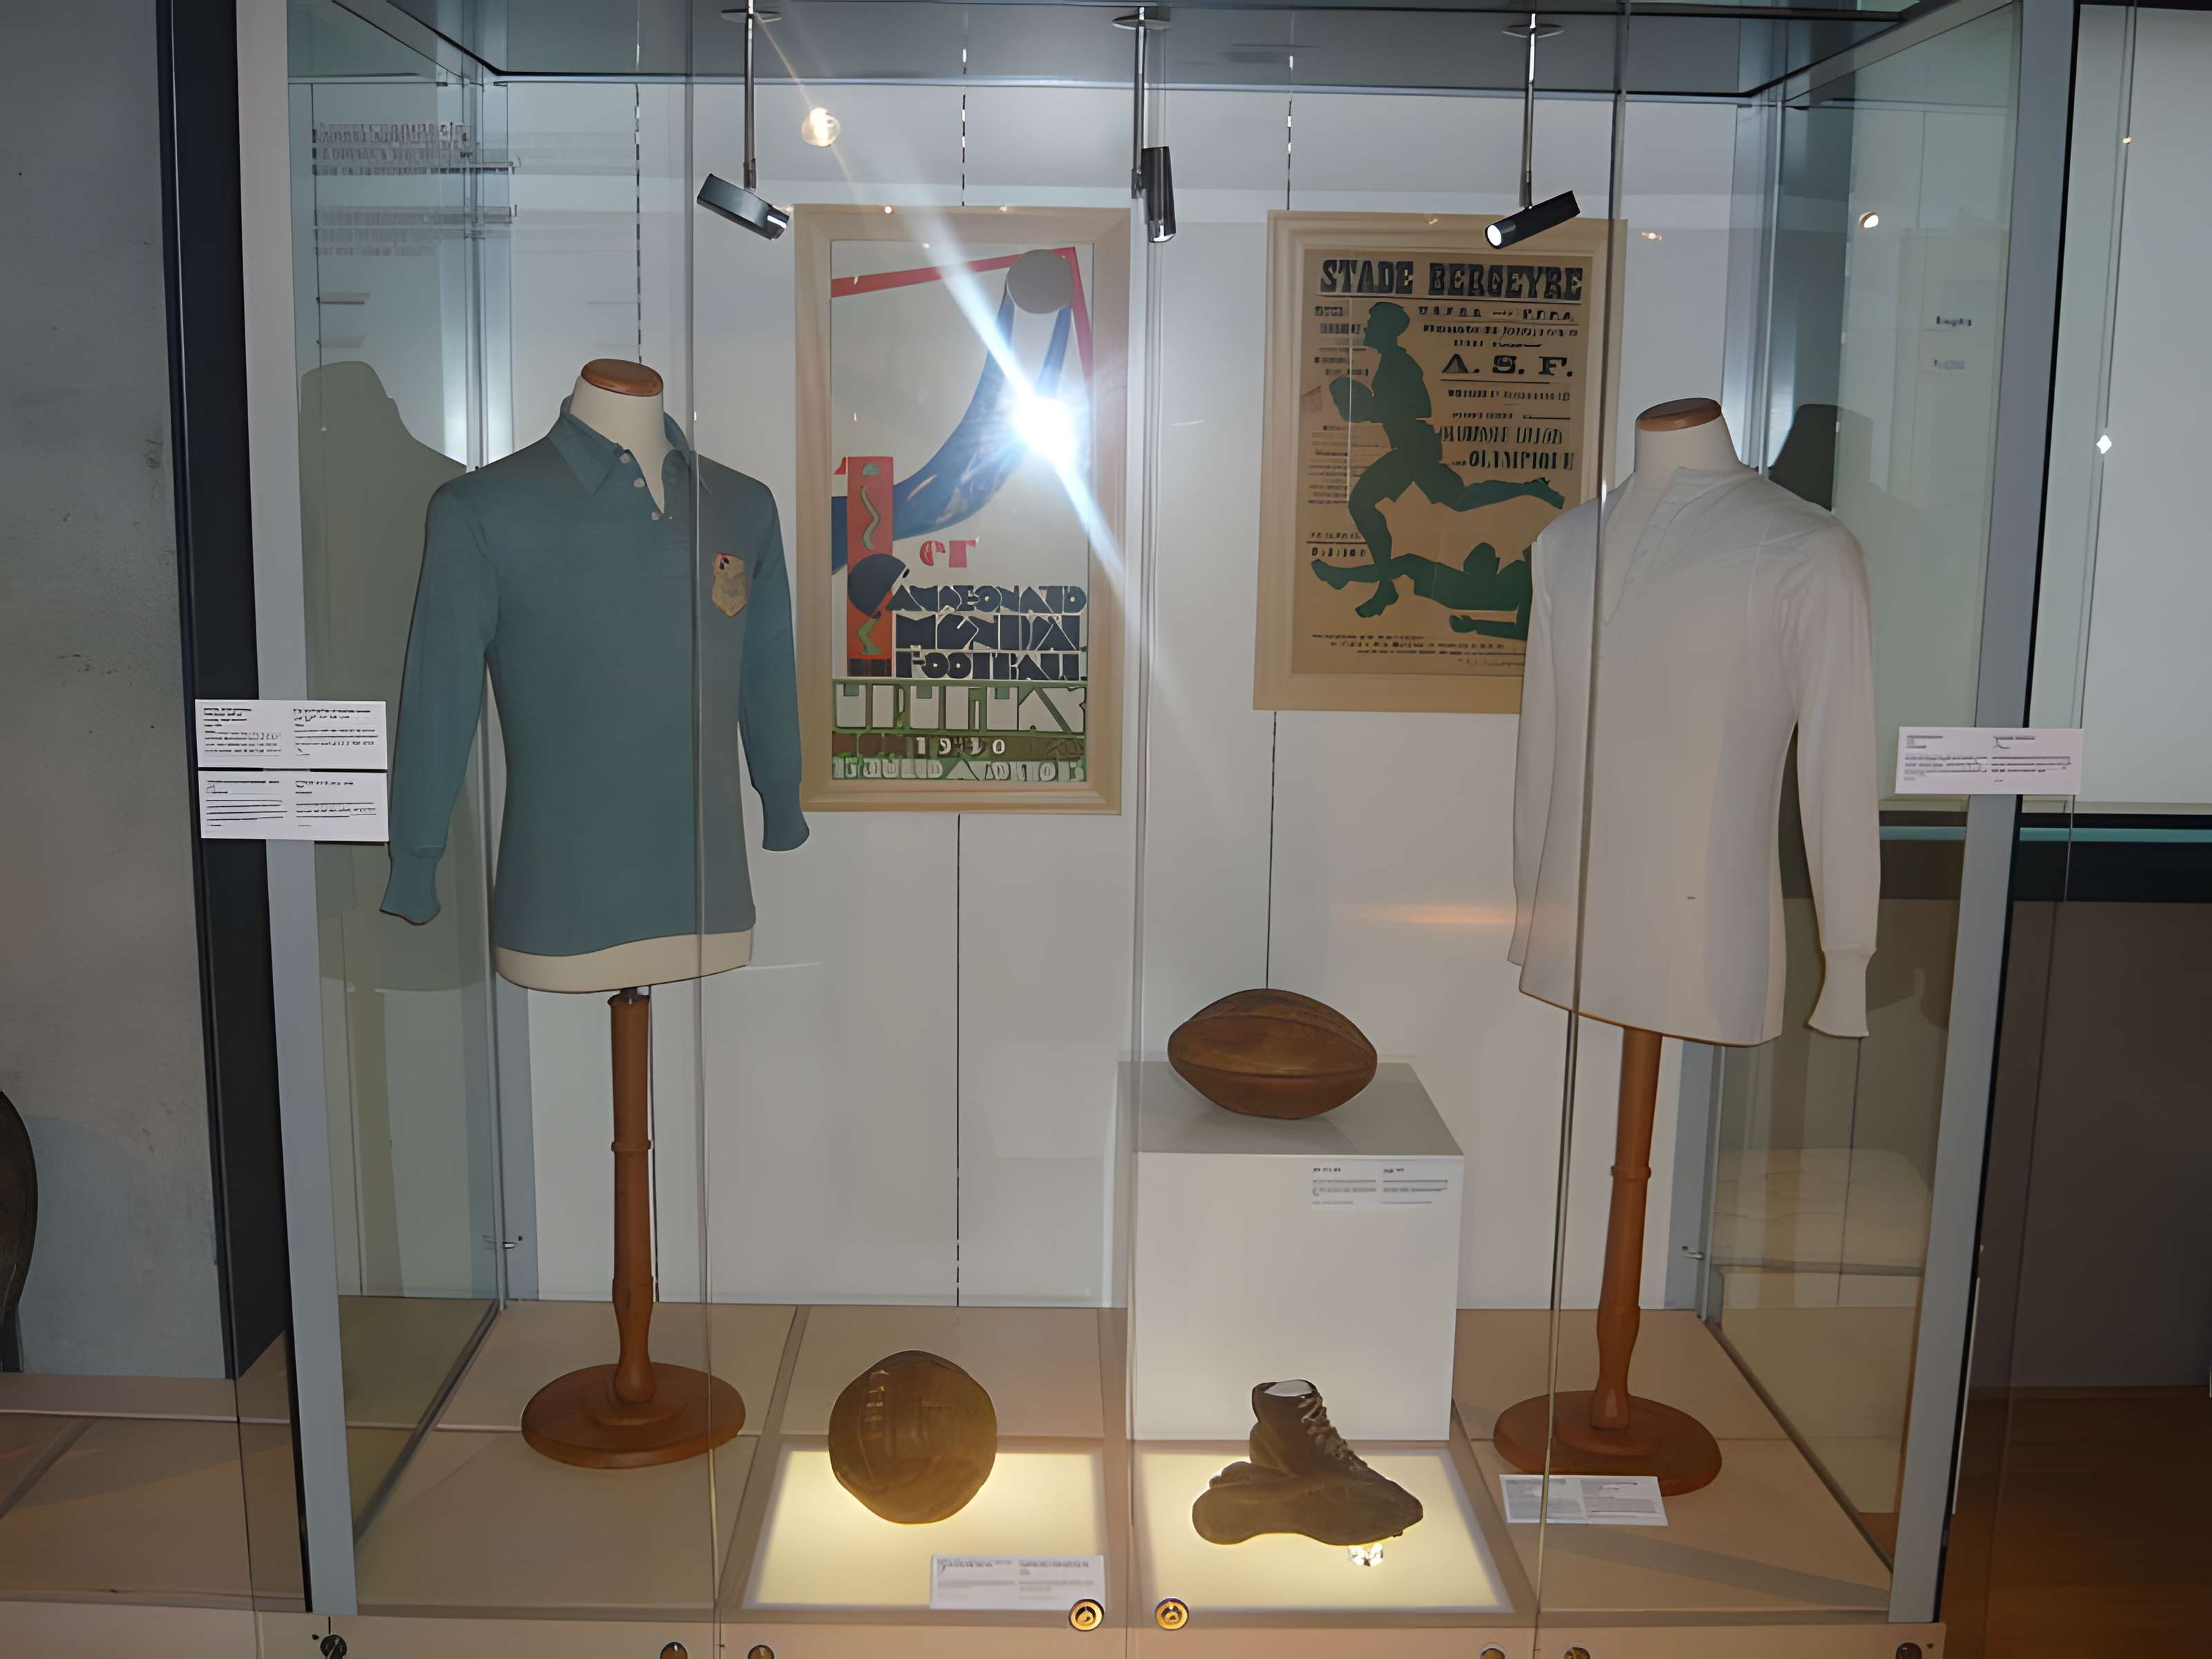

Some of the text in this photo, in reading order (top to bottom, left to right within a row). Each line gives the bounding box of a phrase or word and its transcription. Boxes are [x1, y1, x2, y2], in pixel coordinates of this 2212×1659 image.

[1320, 259, 1583, 300] STADE BERGEYRE
[1538, 356, 1573, 377] F.
